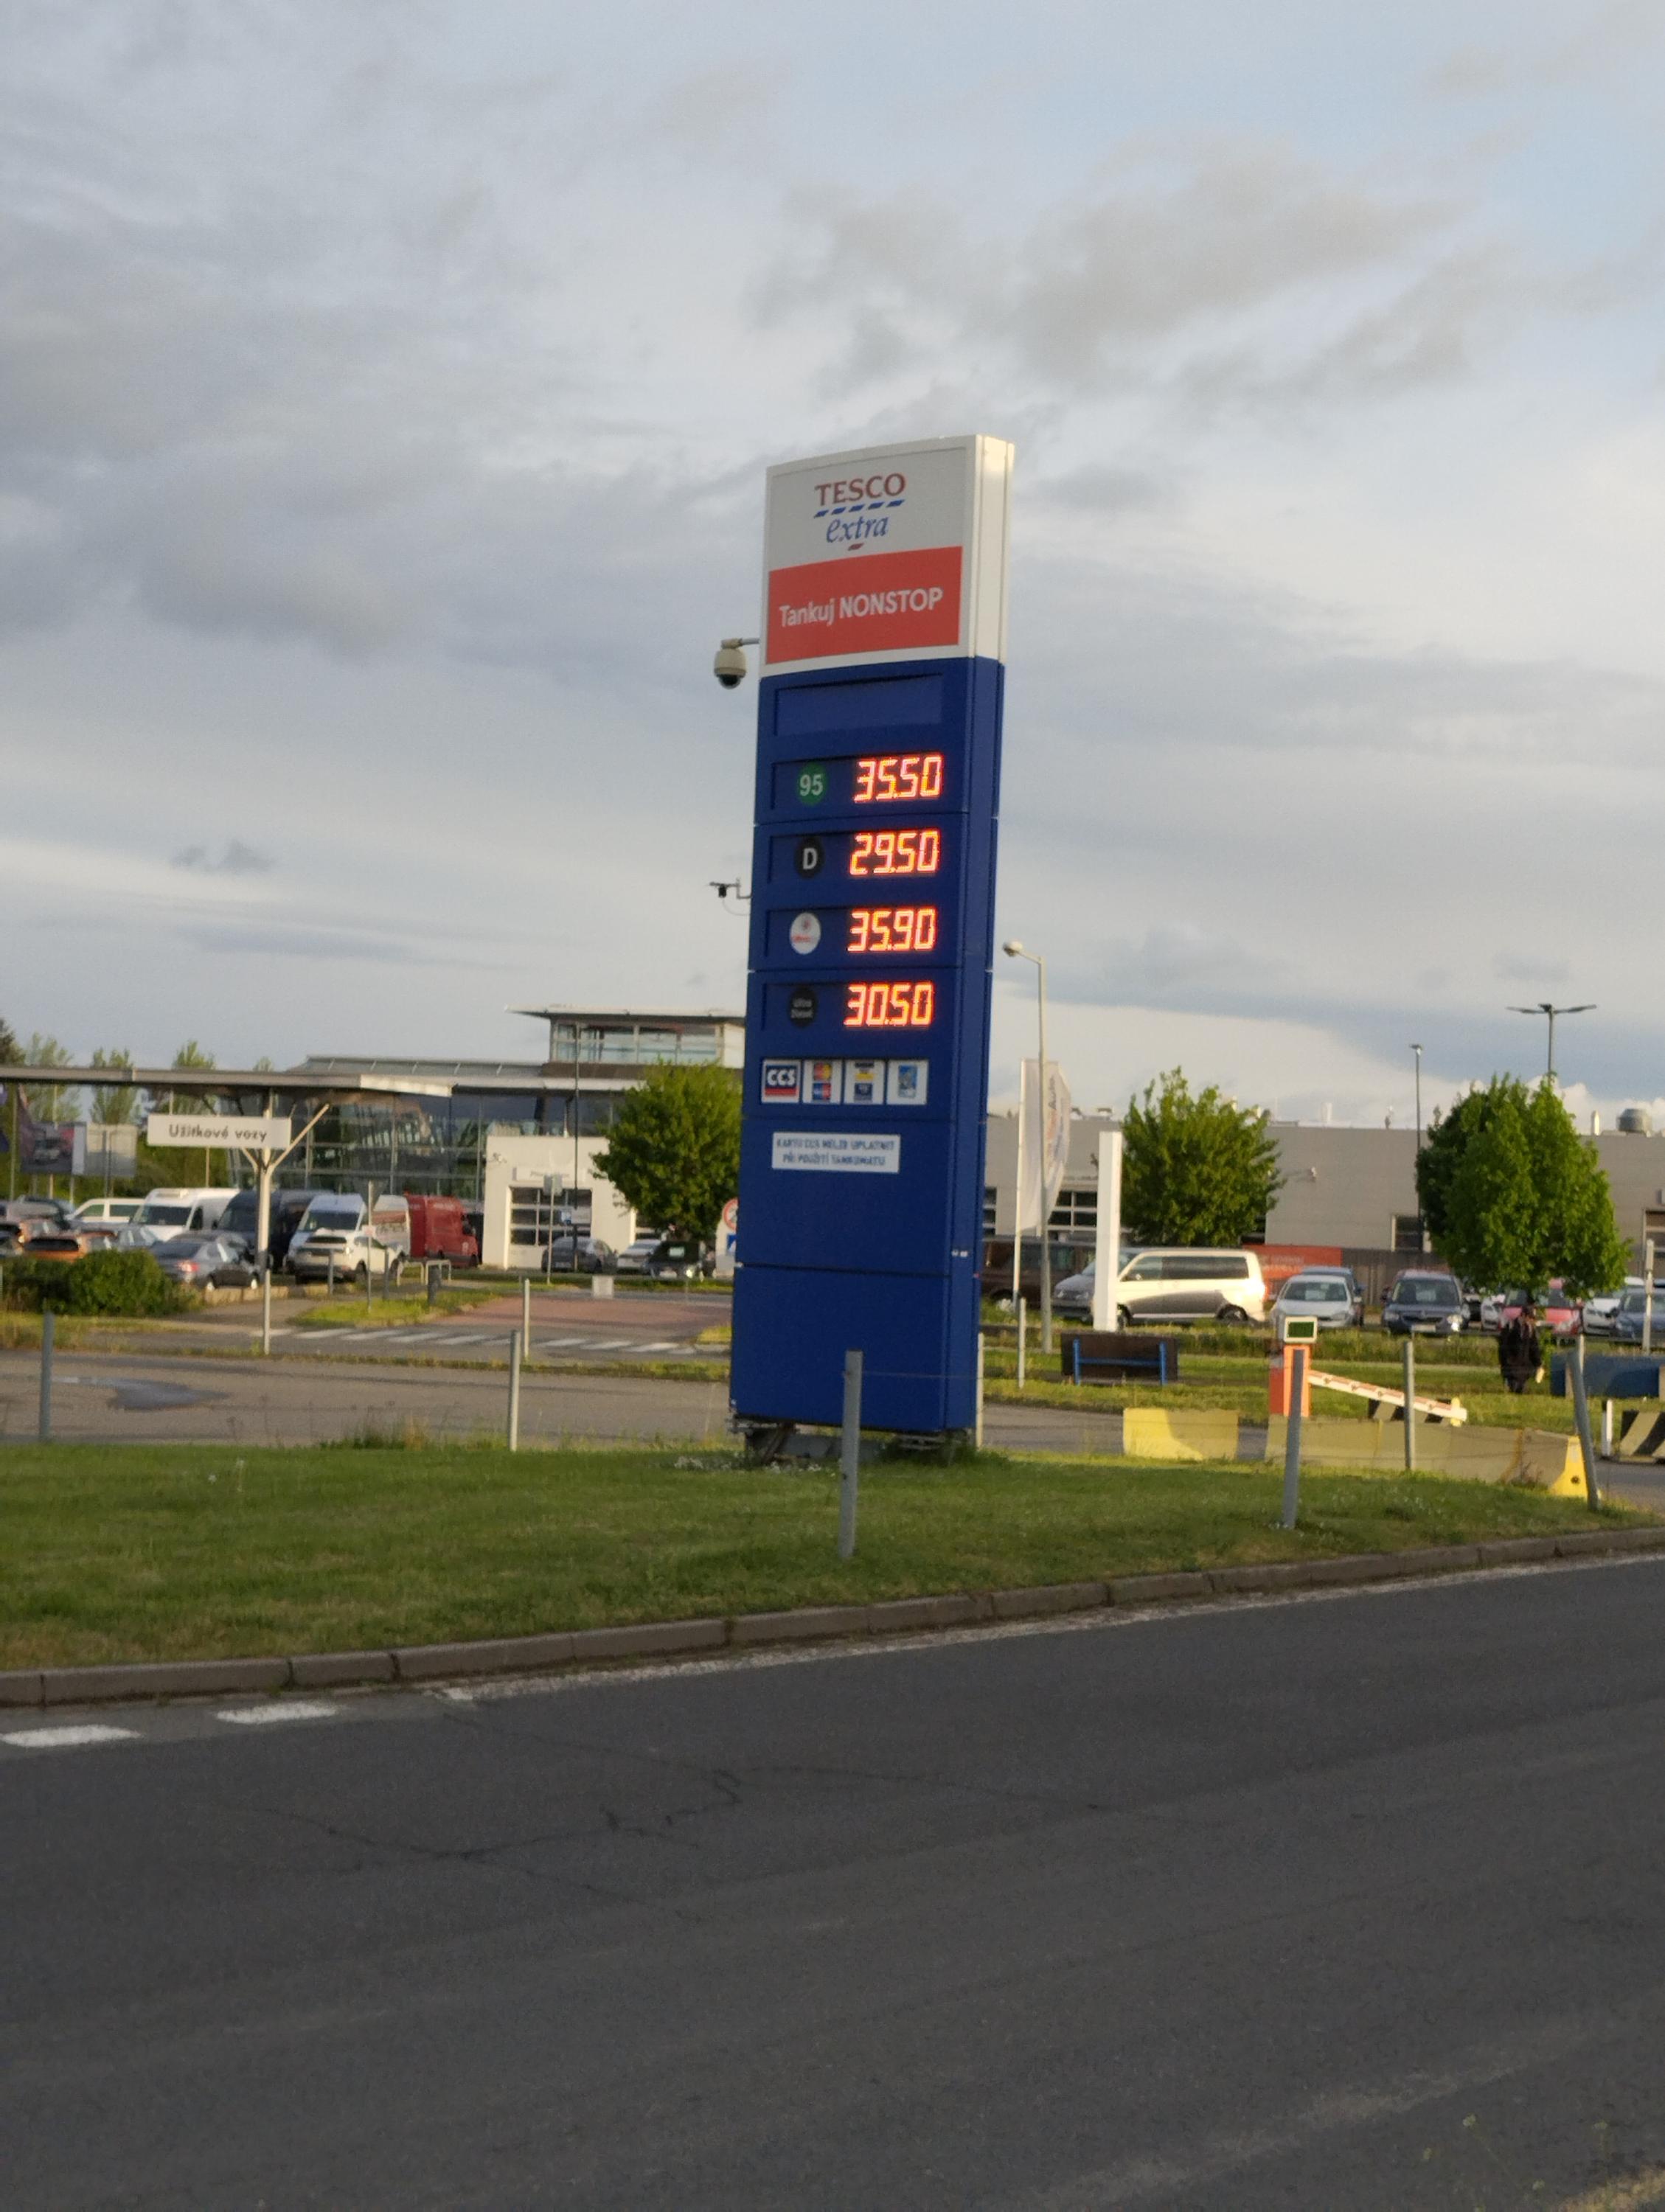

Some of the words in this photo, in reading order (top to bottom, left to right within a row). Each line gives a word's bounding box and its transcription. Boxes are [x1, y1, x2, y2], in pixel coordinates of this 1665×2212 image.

[814, 473, 906, 506] TESCO
[826, 516, 889, 543] extra
[779, 598, 835, 627] Tankuj
[839, 587, 943, 619] NONSTOP
[799, 774, 824, 796] 95
[802, 847, 818, 870] D
[768, 1069, 796, 1086] CCS
[234, 1129, 267, 1141] vozy
